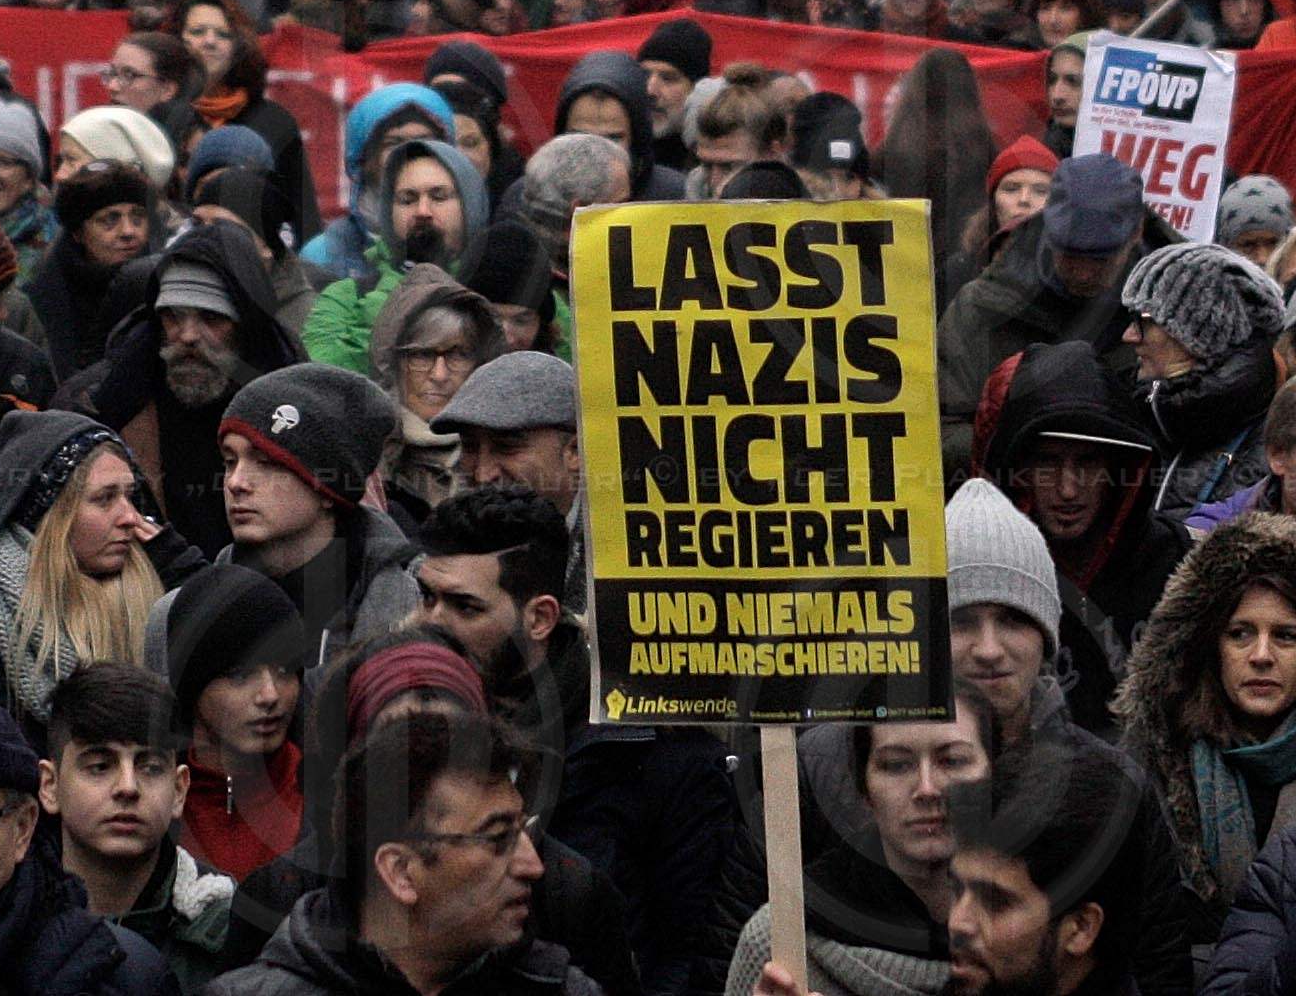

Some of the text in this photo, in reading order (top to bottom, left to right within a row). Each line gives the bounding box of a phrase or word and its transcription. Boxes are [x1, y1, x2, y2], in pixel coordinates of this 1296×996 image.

[1100, 62, 1199, 110] FPÖVP
[608, 220, 895, 311] LASST
[613, 315, 903, 406] NAZIS
[618, 413, 907, 505] NICHT
[625, 509, 911, 569] REGIEREN
[629, 590, 915, 636] UND NIEMALS
[629, 641, 920, 675] AUFMARSCHIEREN!
[626, 695, 737, 714] Linkswende
